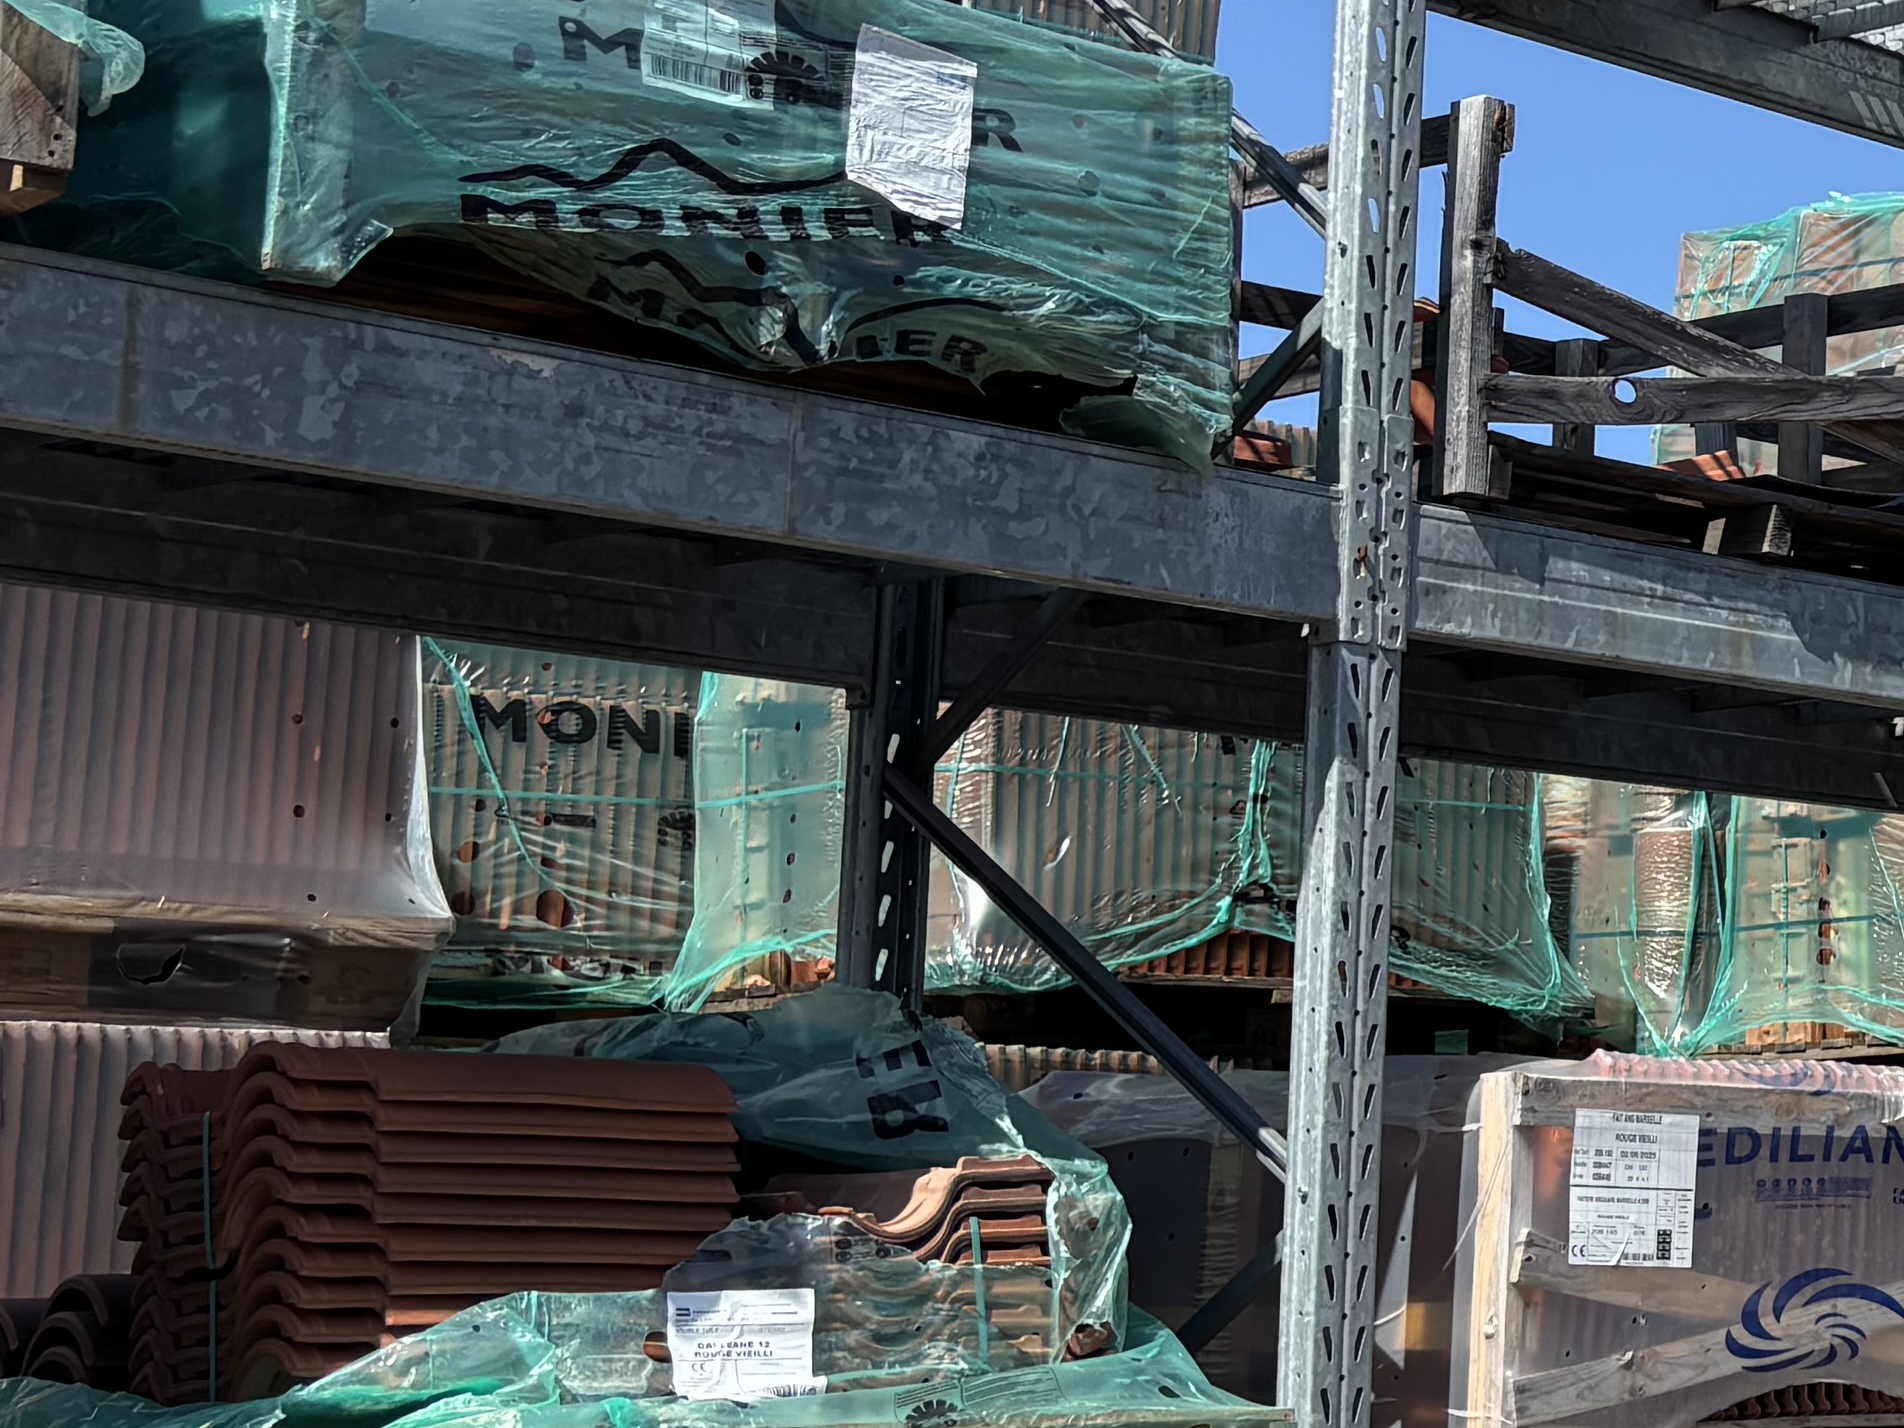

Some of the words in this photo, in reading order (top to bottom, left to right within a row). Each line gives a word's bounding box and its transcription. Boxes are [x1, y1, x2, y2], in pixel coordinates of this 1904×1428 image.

[459, 194, 952, 247] MONIER
[468, 694, 690, 757] MONI
[697, 1340, 754, 1349] GALEANE
